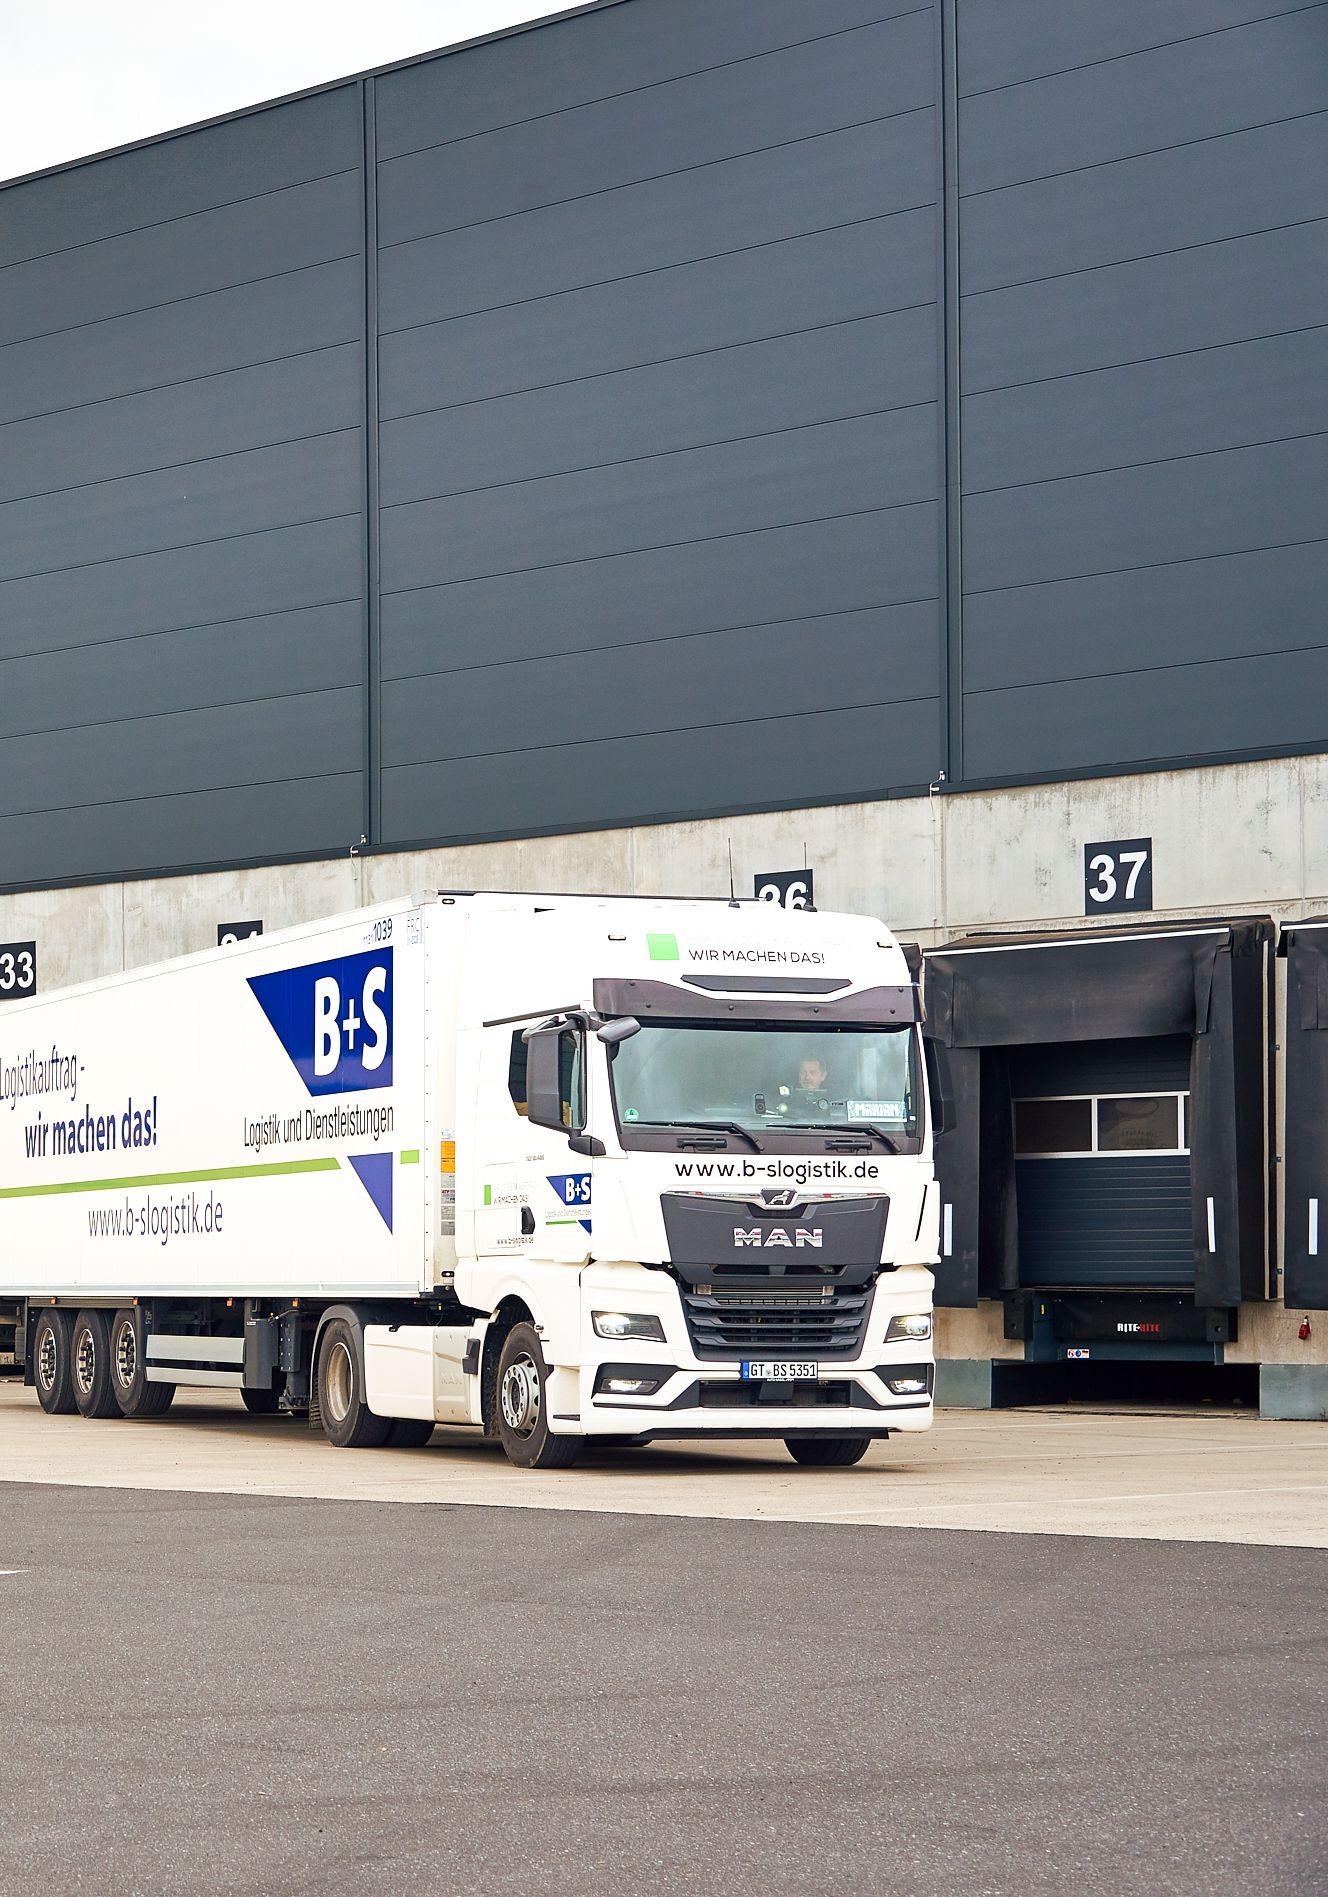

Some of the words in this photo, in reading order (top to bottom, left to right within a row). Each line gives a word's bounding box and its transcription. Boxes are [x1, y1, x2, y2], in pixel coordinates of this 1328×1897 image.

[1089, 851, 1148, 903] 37
[373, 917, 393, 942] 1039
[688, 949, 719, 961] WIR
[722, 949, 787, 963] MACHEN
[790, 951, 826, 964] DAS!
[314, 966, 388, 1077] B+S
[0, 1045, 77, 1111] Logistikauftrag
[25, 1110, 49, 1158] wir
[53, 1103, 116, 1156] machen
[122, 1095, 157, 1149] das!
[244, 1113, 281, 1153] Logistik
[283, 1110, 302, 1142] und
[305, 1103, 394, 1142] Dienstleistungen
[565, 1176, 591, 1202] B+S
[674, 1159, 880, 1185] www.b-slogistik.de
[88, 1189, 224, 1246] www.b-slogistik.de
[733, 1227, 823, 1248] MAN
[750, 1363, 765, 1377] GT
[773, 1363, 787, 1377] BS
[789, 1363, 816, 1377] 5351
